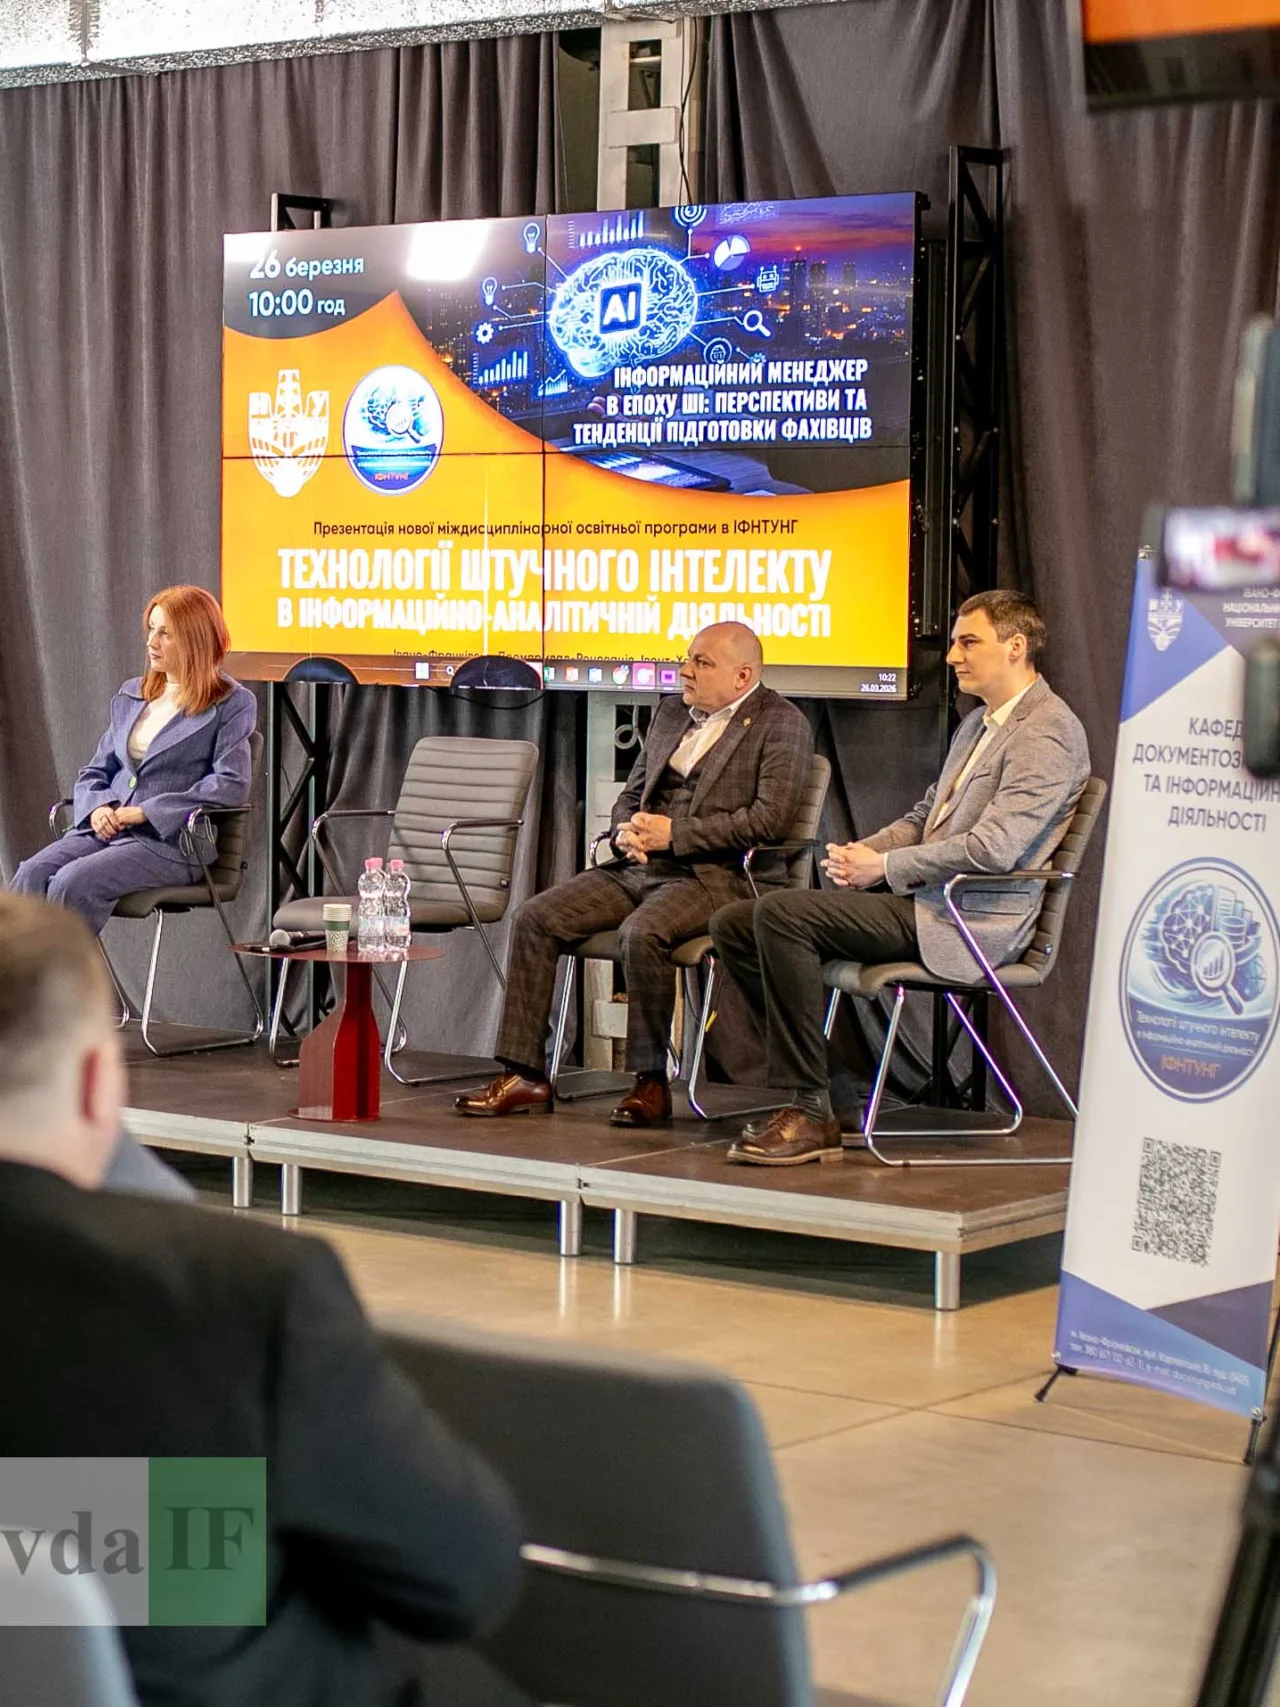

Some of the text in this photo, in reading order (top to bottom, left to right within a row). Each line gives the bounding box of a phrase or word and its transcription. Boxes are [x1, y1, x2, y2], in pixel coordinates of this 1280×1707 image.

[249, 249, 364, 281] 26 березня
[248, 288, 346, 317] 10:00 год
[602, 291, 637, 326] AI
[614, 358, 868, 389] ІНФОРМАЦІЙНИЙ МЕНЕДЖЕР
[606, 388, 867, 418] В ЕПОХУ ШІ: ПЕРСПЕКТИВИ ТА
[573, 417, 873, 447] ТЕНДЕНЦІЇ ПІДГОТОВКИ ФАХІВЦІВ
[314, 519, 798, 538] Презентація нової міждисциплінарної освітньої програми в ІФНТУНГ
[278, 540, 832, 601] ТЕХНОЛОГІЇ ШТУЧНОГО ІНТЕЛЕКТУ
[277, 597, 293, 628] В
[299, 592, 660, 636] ІНФОРМАЦІЙНО-АНАЛІТИЧНІЙ
[860, 684, 897, 692] 26.03.2026
[878, 673, 896, 681] 10:22
[1188, 717, 1244, 741] КАФЕД
[1144, 774, 1161, 792] ТА
[1168, 806, 1267, 833] ДІЯЛЬНОСТІ
